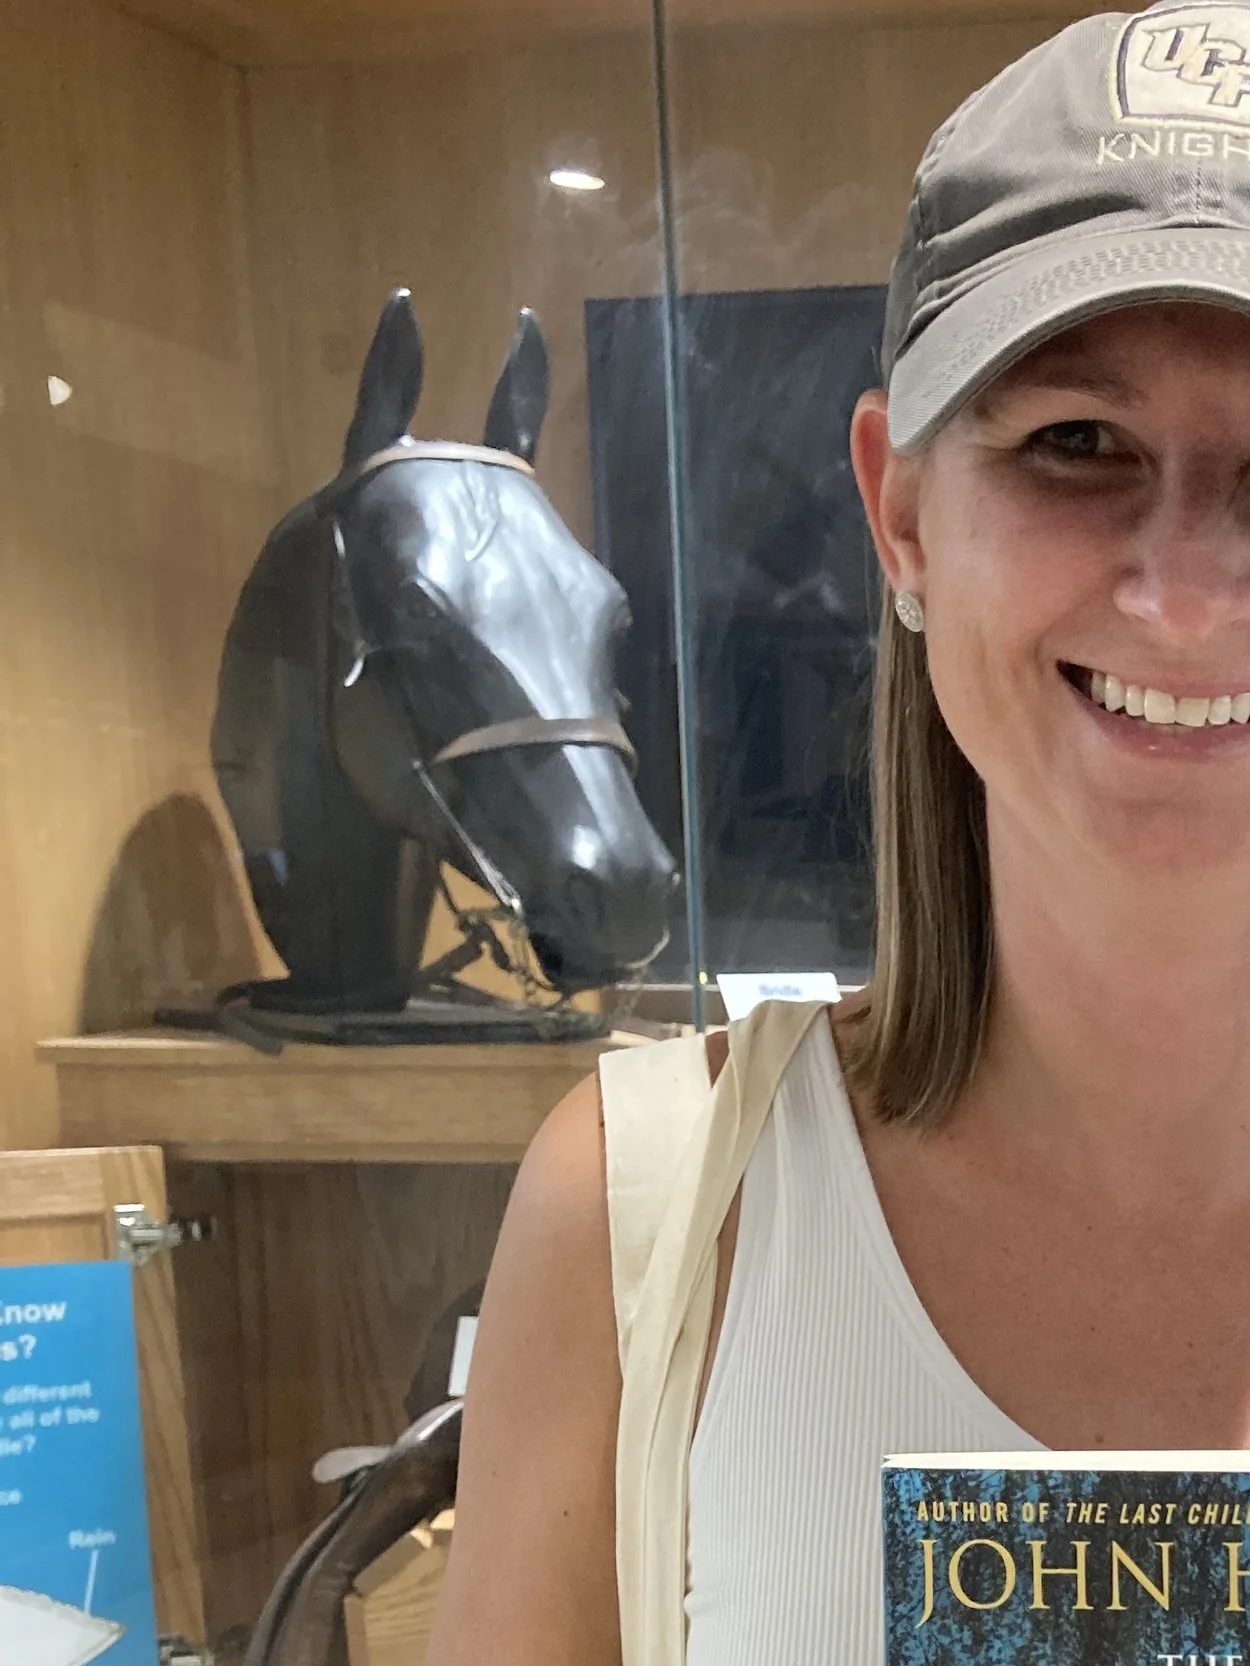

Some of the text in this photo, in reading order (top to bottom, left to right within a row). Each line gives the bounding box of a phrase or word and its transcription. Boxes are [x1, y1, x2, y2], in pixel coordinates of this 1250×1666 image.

[917, 1500, 1009, 1523] AUTHOR
[1022, 1501, 1050, 1523] OF
[1066, 1502, 1109, 1524] THE
[1119, 1502, 1177, 1524] LAST
[914, 1538, 1177, 1629] JOHN
